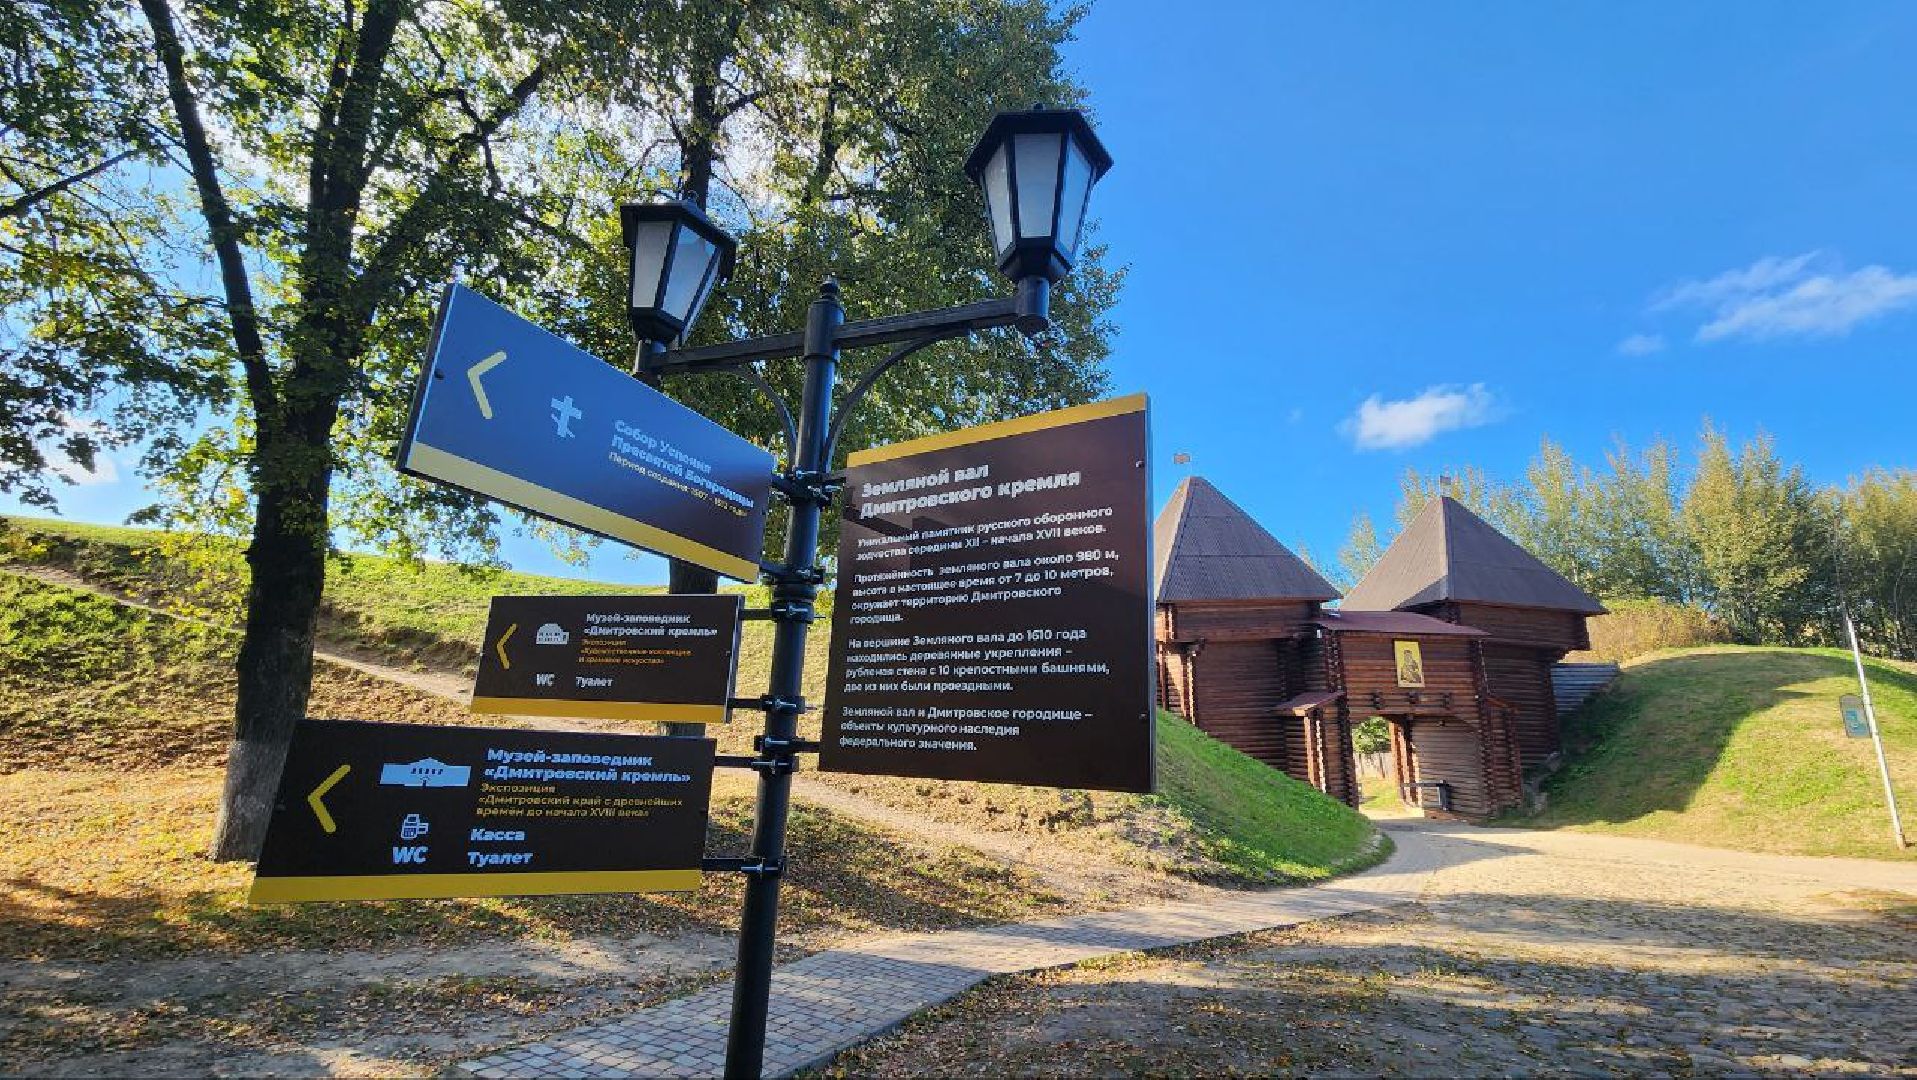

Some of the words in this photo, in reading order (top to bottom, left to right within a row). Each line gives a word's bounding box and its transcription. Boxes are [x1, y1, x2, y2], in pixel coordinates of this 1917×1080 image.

[615, 420, 657, 449] Собор
[660, 441, 711, 473] Успения
[609, 452, 646, 475] Период
[612, 435, 683, 476] Пресвятой
[685, 469, 753, 508] Богородицы
[862, 468, 949, 498] Земляной
[955, 464, 989, 482] вал
[860, 485, 993, 519] Дмитровского
[998, 470, 1081, 498] кремля
[858, 530, 920, 548] Уникальный
[922, 524, 975, 540] памятник
[978, 517, 1031, 534] русского
[1034, 507, 1113, 524] оборонного
[856, 547, 906, 561] зодчества
[909, 540, 962, 556] середины
[965, 537, 980, 548] XII
[991, 532, 1033, 545] начала
[1036, 528, 1060, 540] XVII
[1064, 524, 1106, 536] веков.
[940, 561, 998, 576] земляного
[1003, 557, 1031, 569] вала
[1034, 553, 1073, 566] около
[1076, 550, 1100, 562] 980
[1106, 551, 1119, 561] м,
[852, 585, 886, 597] высота
[890, 586, 895, 594] в
[898, 579, 956, 594] настоящее
[959, 577, 994, 589] время
[998, 575, 1012, 585] от
[1015, 573, 1022, 582] 7
[1024, 572, 1041, 583] до
[1044, 569, 1057, 580] 10
[1060, 566, 1113, 581] метров,
[851, 599, 899, 611] окружает
[901, 593, 968, 607] территорию
[971, 586, 1062, 603] Дмитровского
[587, 614, 690, 624] Музей-заповедник
[850, 614, 903, 625] городища.
[584, 625, 664, 636] «Дмитровский
[668, 628, 717, 637] кремль»
[849, 639, 862, 649] На
[863, 636, 910, 649] вершине
[913, 635, 974, 646] Земляного
[977, 633, 1005, 643] вала
[1007, 632, 1024, 643] до
[1027, 630, 1052, 641] 1610
[1056, 629, 1086, 640] года
[847, 652, 907, 664] находились
[909, 650, 980, 664] деревянные
[984, 647, 1062, 660] укрепления
[846, 666, 894, 678] рубленая
[896, 666, 927, 676] стена
[930, 667, 936, 675] с
[939, 664, 949, 675] 10
[953, 665, 1037, 678] крепостными
[1041, 662, 1110, 676] башнями,
[536, 674, 555, 686] WC
[576, 676, 613, 687] Туалет
[844, 682, 862, 692] две
[865, 682, 876, 690] из
[880, 682, 898, 691] них
[900, 680, 930, 691] были
[934, 682, 1013, 693] проездными.
[842, 706, 892, 718] Земляной
[896, 708, 915, 718] вал
[918, 710, 925, 718] и
[927, 706, 1009, 721] Дмитровское
[1012, 709, 1082, 722] городище
[840, 722, 884, 732] объекты
[886, 722, 956, 735] культурного
[959, 724, 1019, 736] наследия
[839, 735, 915, 748] федерального
[918, 739, 977, 750] значения.
[488, 749, 652, 767] Музей-заповедник
[485, 766, 616, 781] «Дмитровский
[621, 770, 691, 783] кремль»
[481, 783, 555, 793] Экспозиция
[479, 794, 569, 806] «Дмитровский
[573, 795, 600, 806] край
[614, 797, 682, 808] древнейших
[527, 809, 543, 817] до
[546, 808, 587, 817] начала
[589, 807, 615, 817] XVIII
[471, 828, 525, 841] Касса
[393, 846, 428, 864] WC
[468, 852, 532, 867] Туалет
